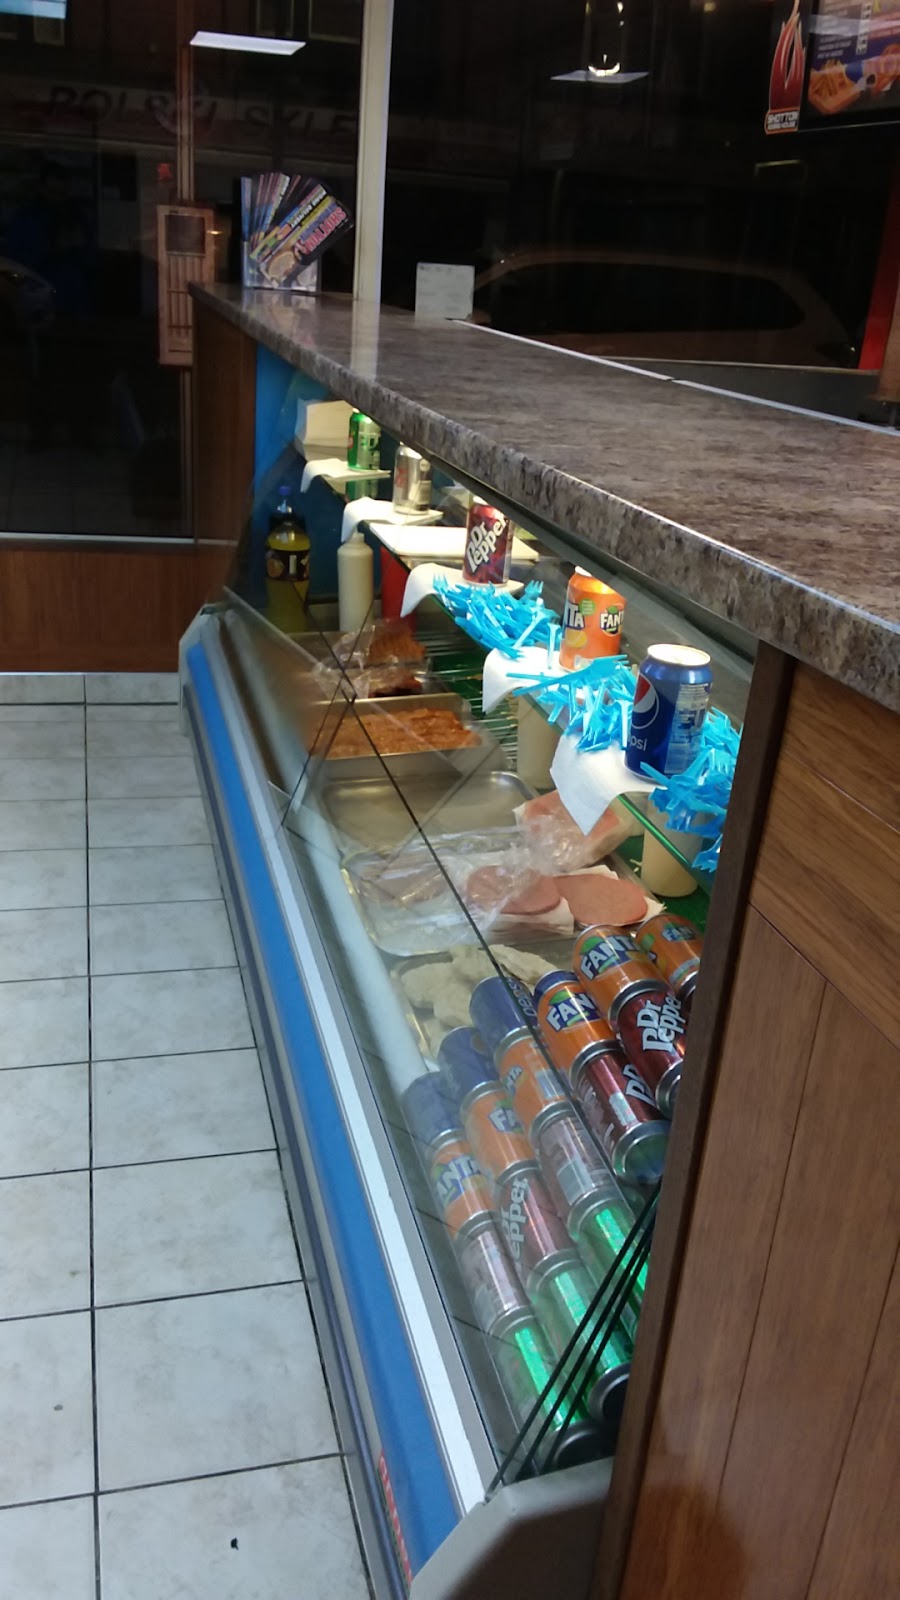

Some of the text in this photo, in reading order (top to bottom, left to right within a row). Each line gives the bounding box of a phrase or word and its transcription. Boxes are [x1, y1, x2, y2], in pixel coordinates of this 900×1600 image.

[471, 521, 488, 549] Dr
[637, 1000, 661, 1028] Dr
[643, 996, 686, 1053] Peppe
